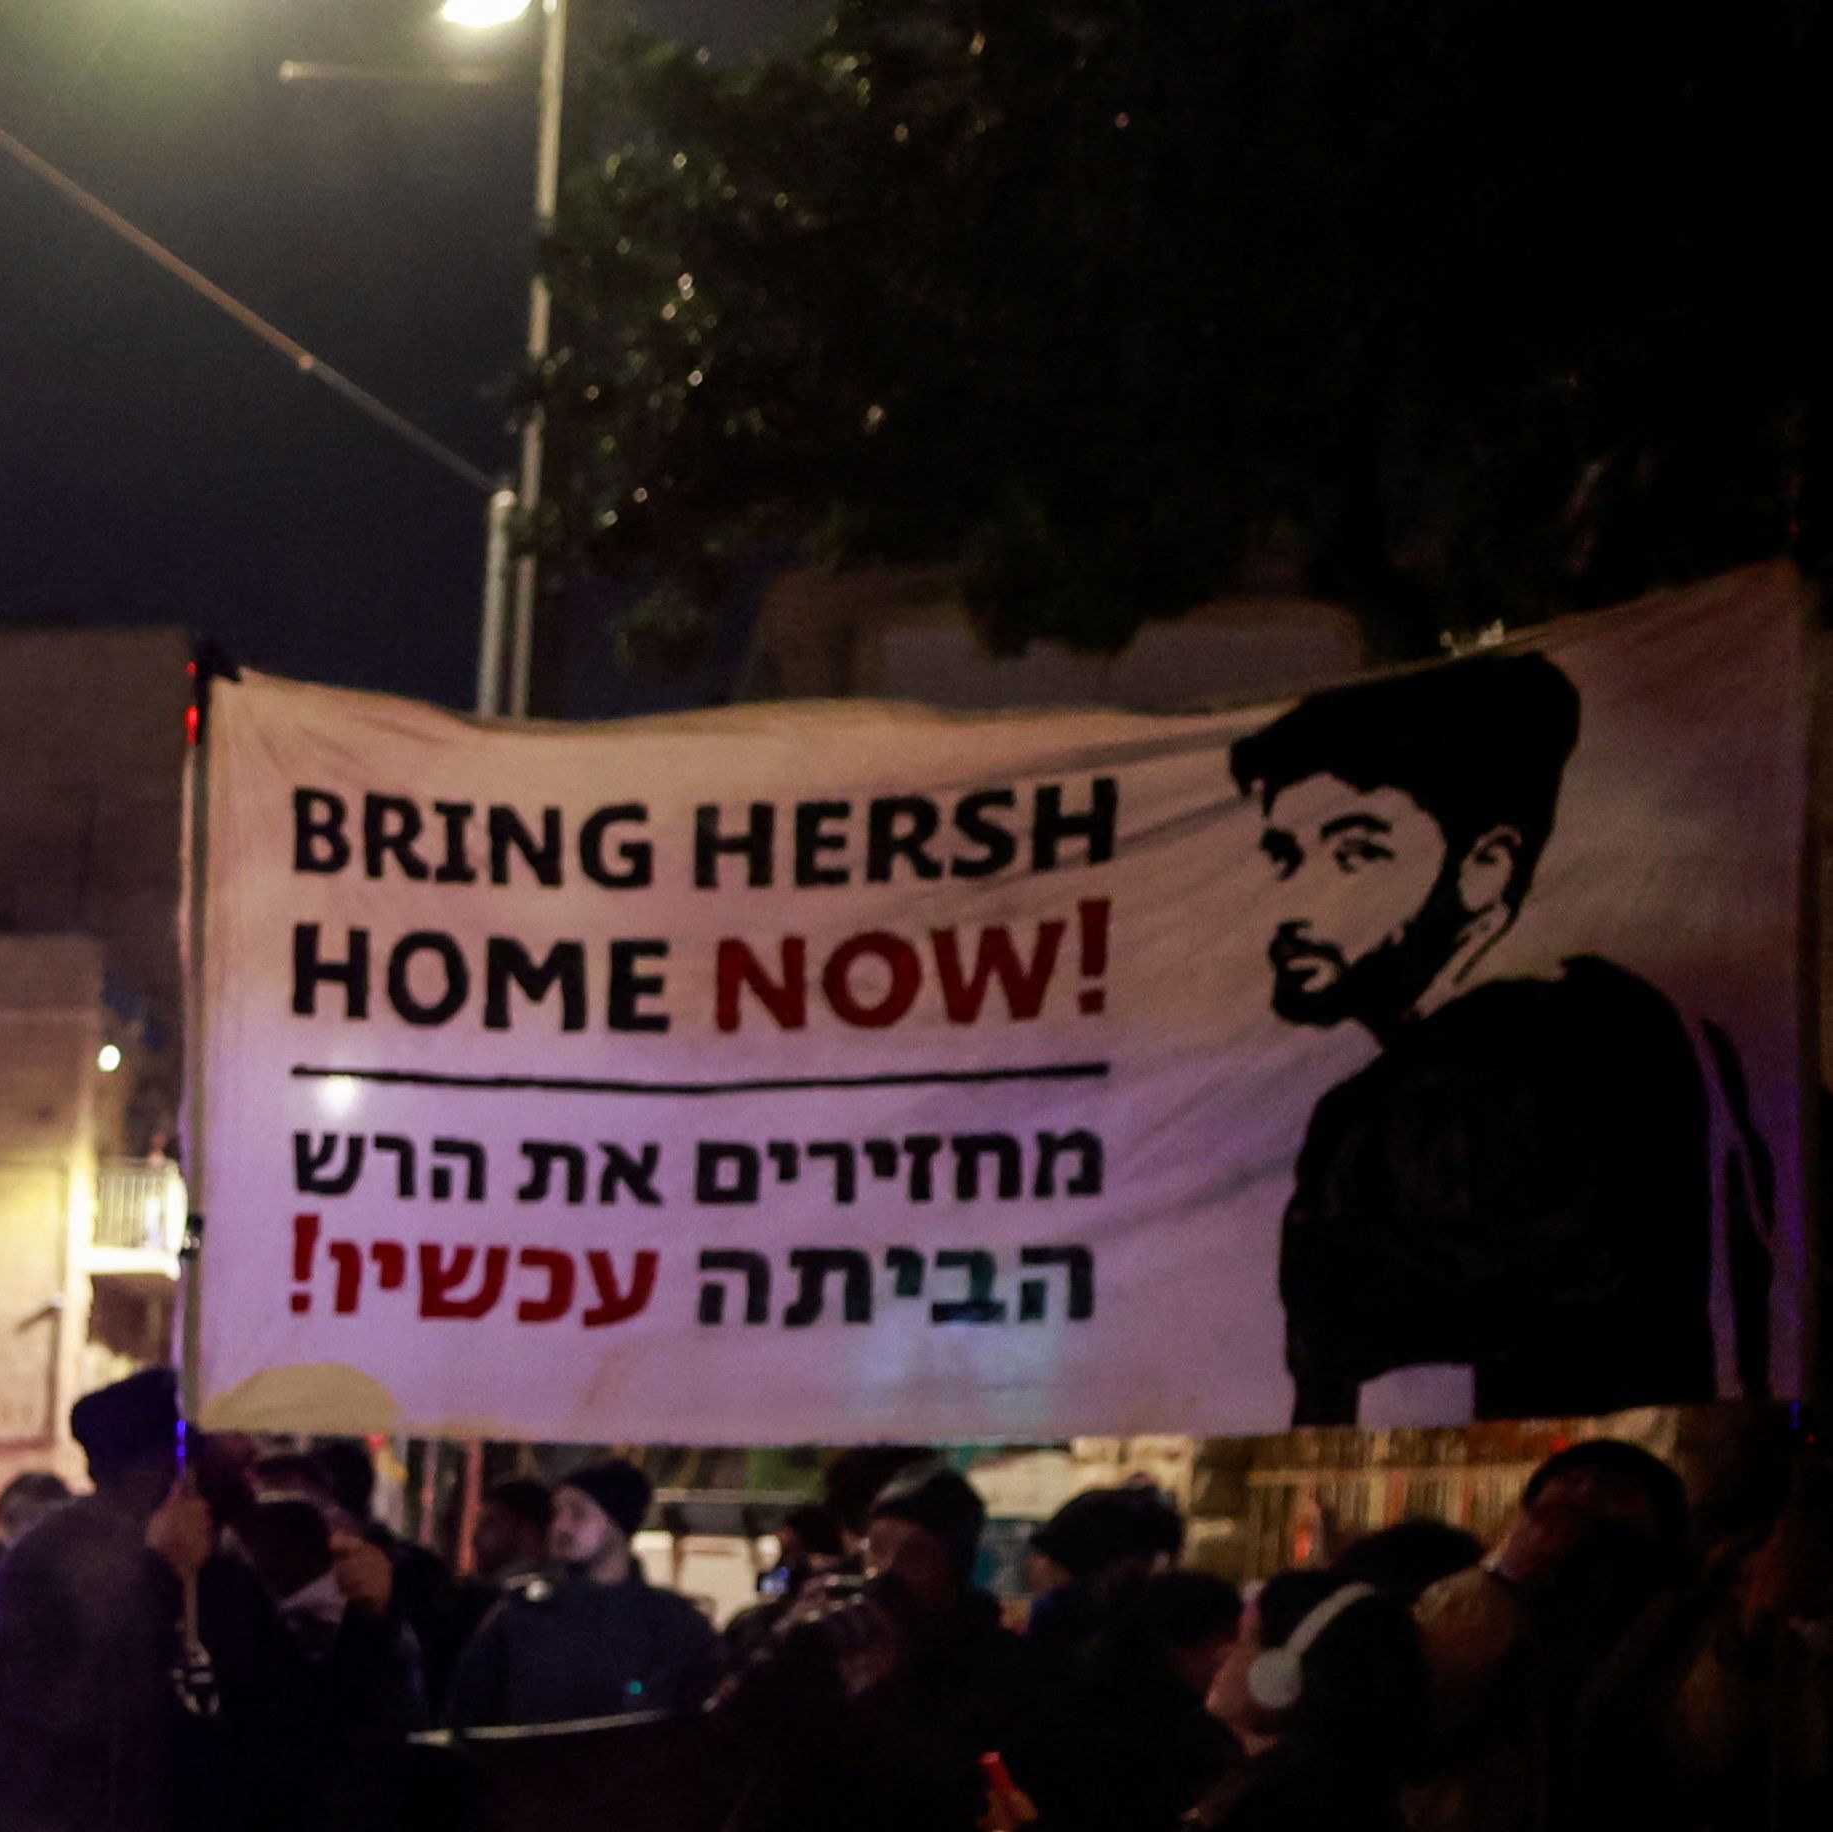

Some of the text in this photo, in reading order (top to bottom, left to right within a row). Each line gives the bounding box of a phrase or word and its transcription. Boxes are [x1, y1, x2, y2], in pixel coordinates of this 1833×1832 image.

[292, 778, 1117, 890] BRING HERSH
[292, 897, 1109, 1032] HOME NOW!
[293, 1130, 1105, 1205] מחזירים את הרש
[290, 1215, 1096, 1326] הביתה עכשיו!
